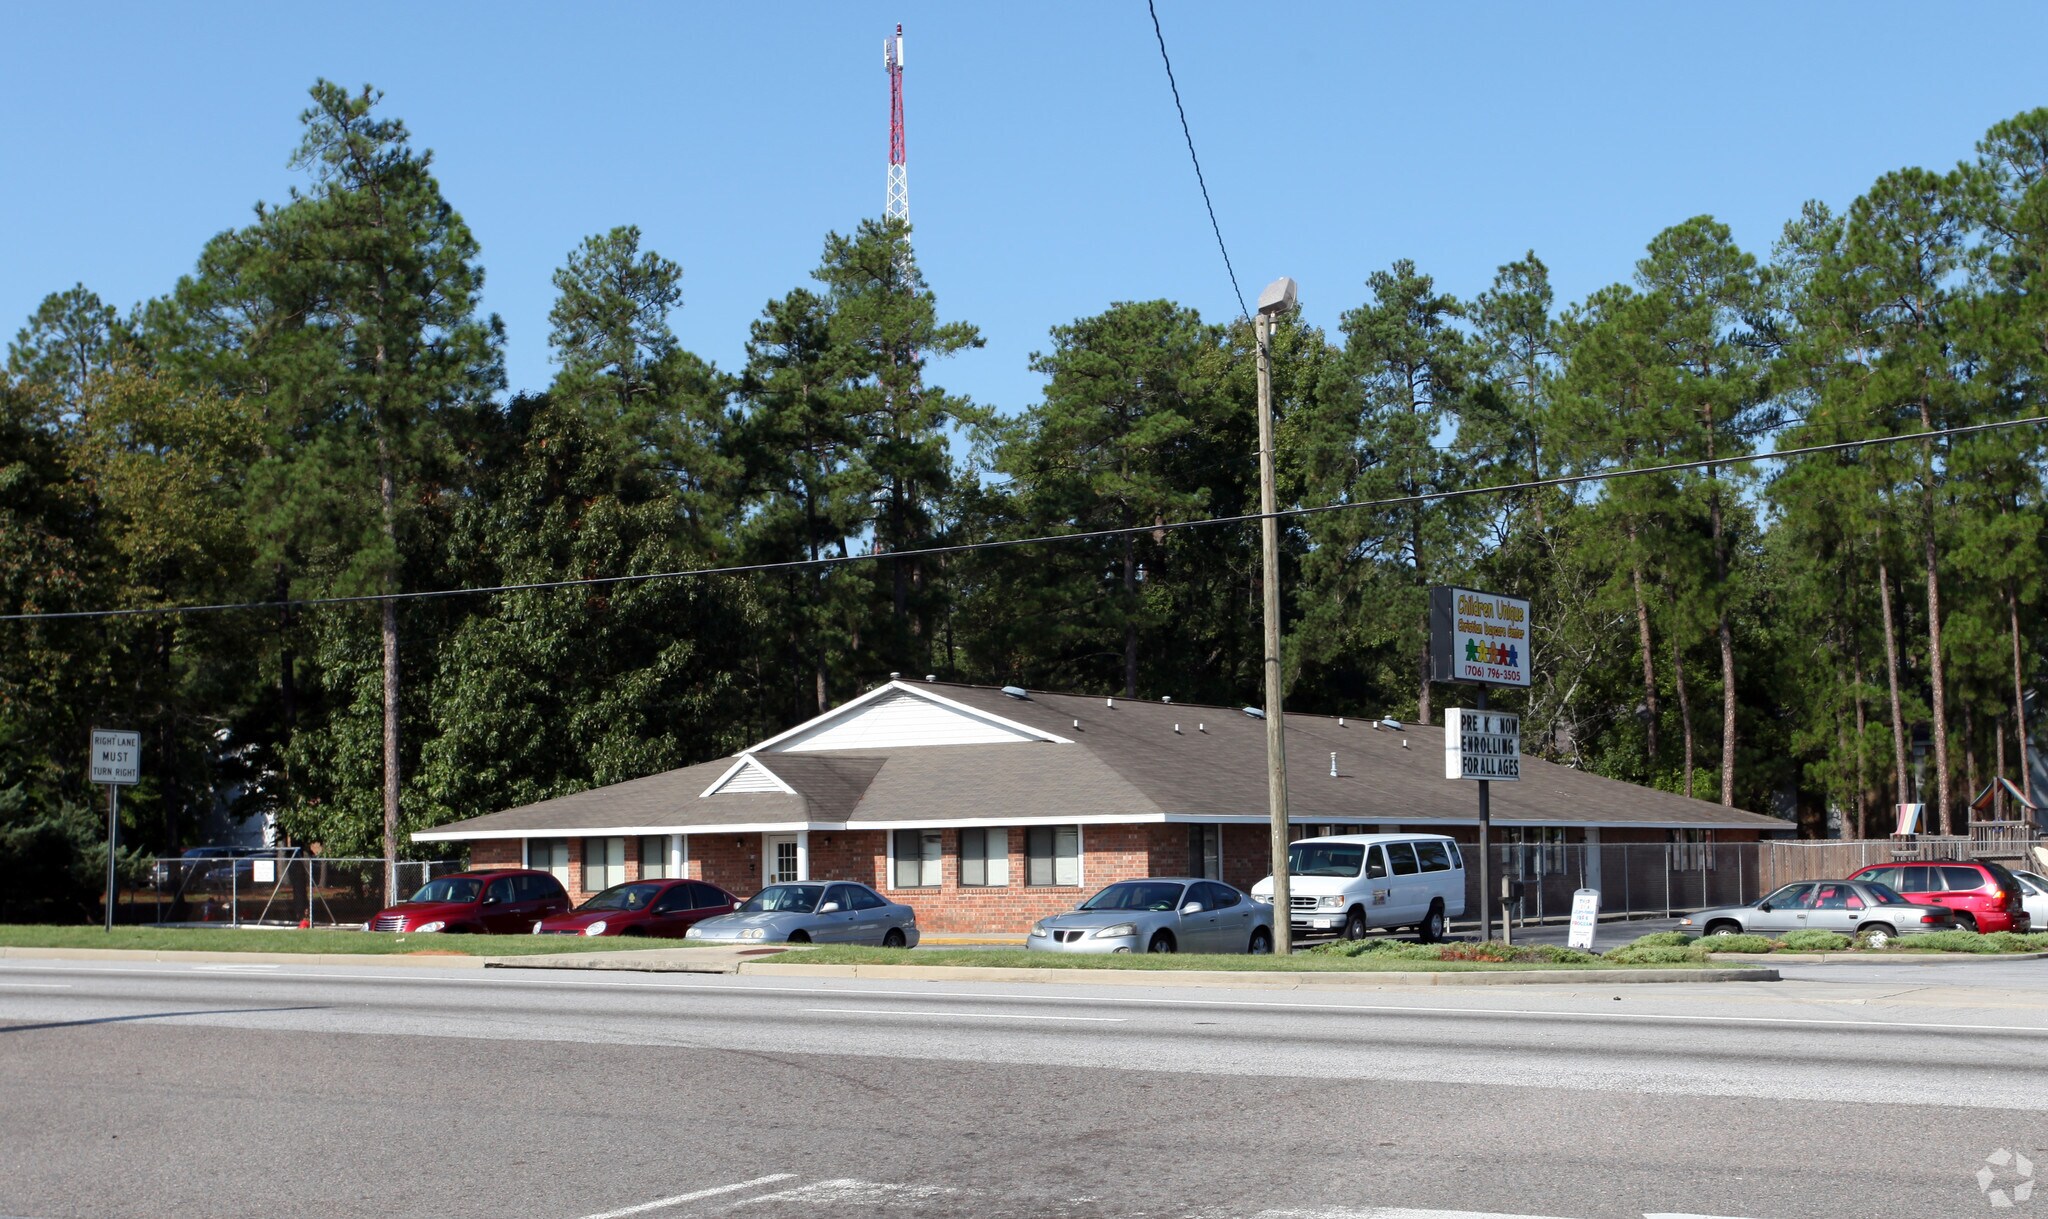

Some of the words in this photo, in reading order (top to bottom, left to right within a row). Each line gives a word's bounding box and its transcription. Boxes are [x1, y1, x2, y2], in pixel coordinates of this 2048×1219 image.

[1458, 594, 1494, 619] Children
[1496, 599, 1525, 626] Unique
[1465, 665, 1484, 677] (706)
[1487, 668, 1520, 681] 796-3505
[1461, 715, 1478, 732] PRE
[1484, 716, 1490, 733] K
[1500, 717, 1518, 735] NOW
[94, 736, 115, 746] RIGHT
[117, 738, 136, 747] LANE
[1461, 736, 1514, 755] ENROLLING
[102, 751, 128, 762] MUST
[93, 767, 112, 776] TURN
[115, 768, 136, 777] RIGHT
[1462, 757, 1479, 774] FOR
[1480, 758, 1496, 775] ALL
[1497, 758, 1519, 776] AGES
